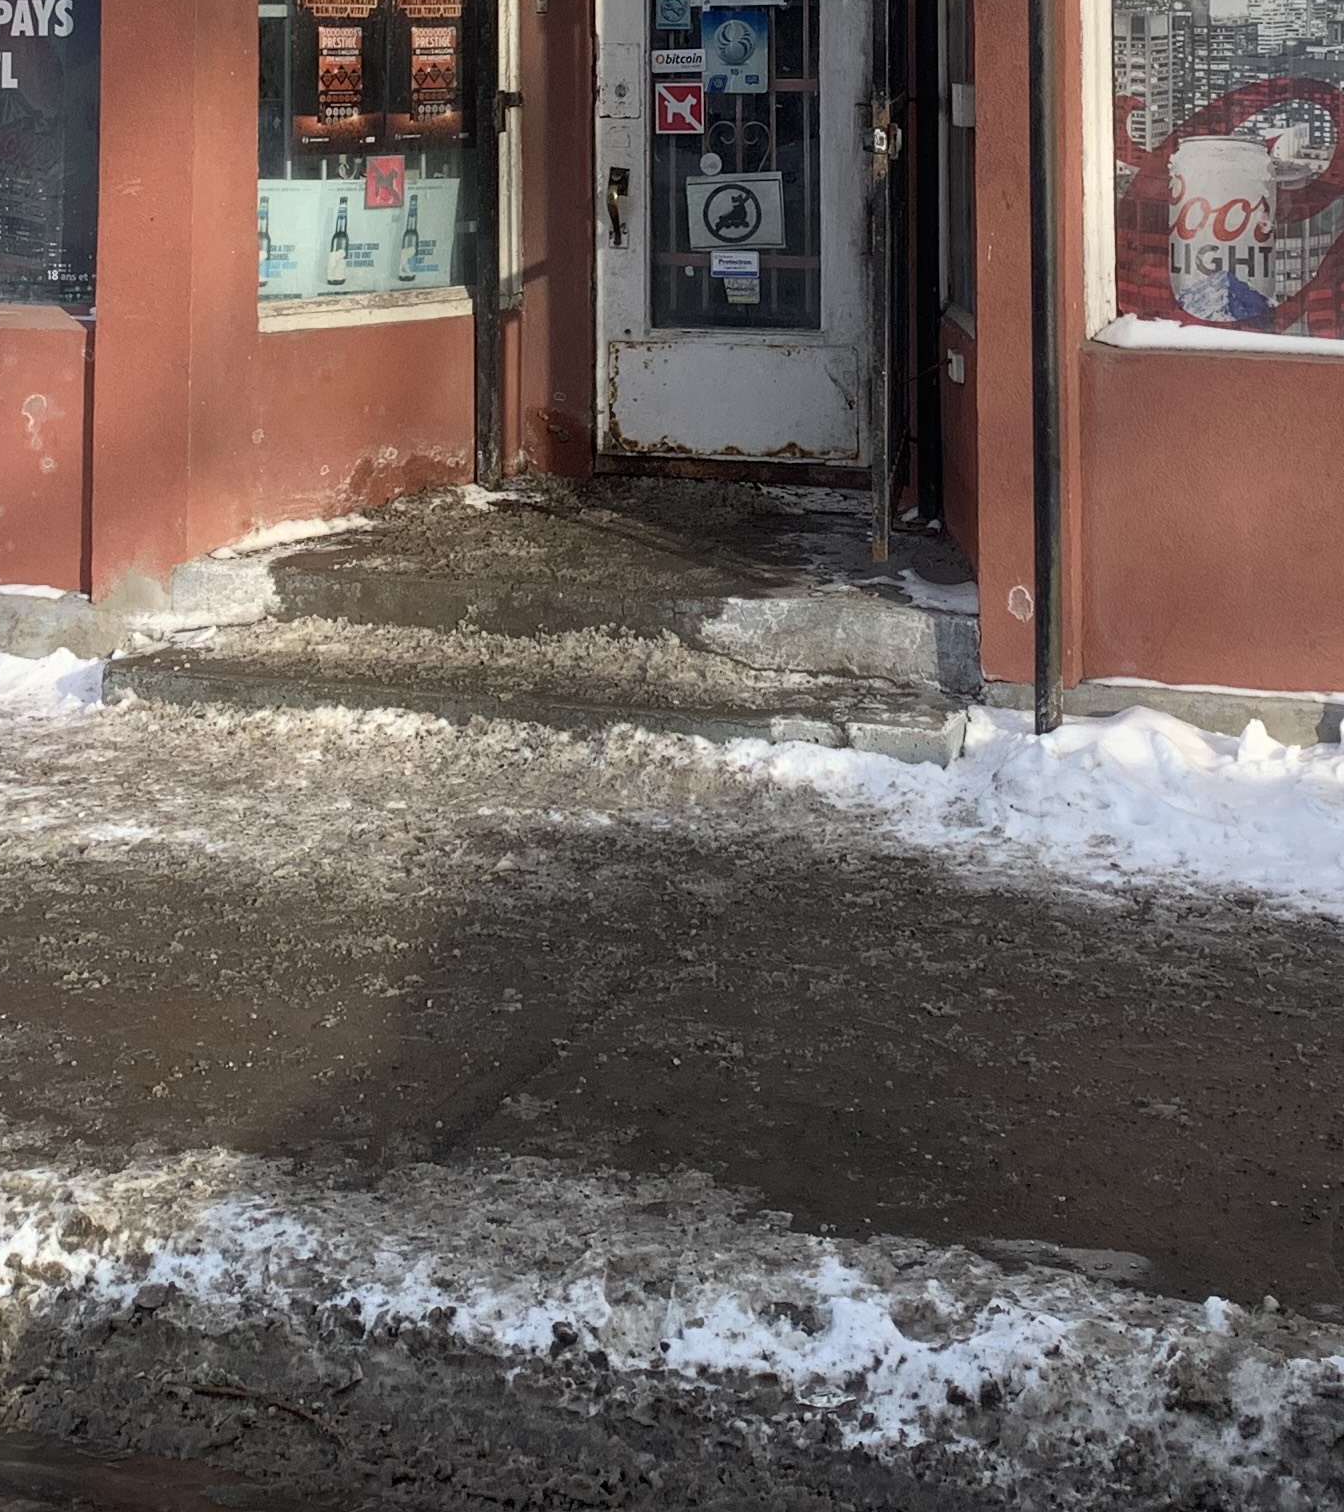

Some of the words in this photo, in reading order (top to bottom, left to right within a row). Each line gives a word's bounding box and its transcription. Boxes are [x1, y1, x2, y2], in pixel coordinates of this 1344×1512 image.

[665, 52, 703, 65] bitcoin
[1170, 242, 1273, 278] LIGHT
[47, 269, 59, 281] 18
